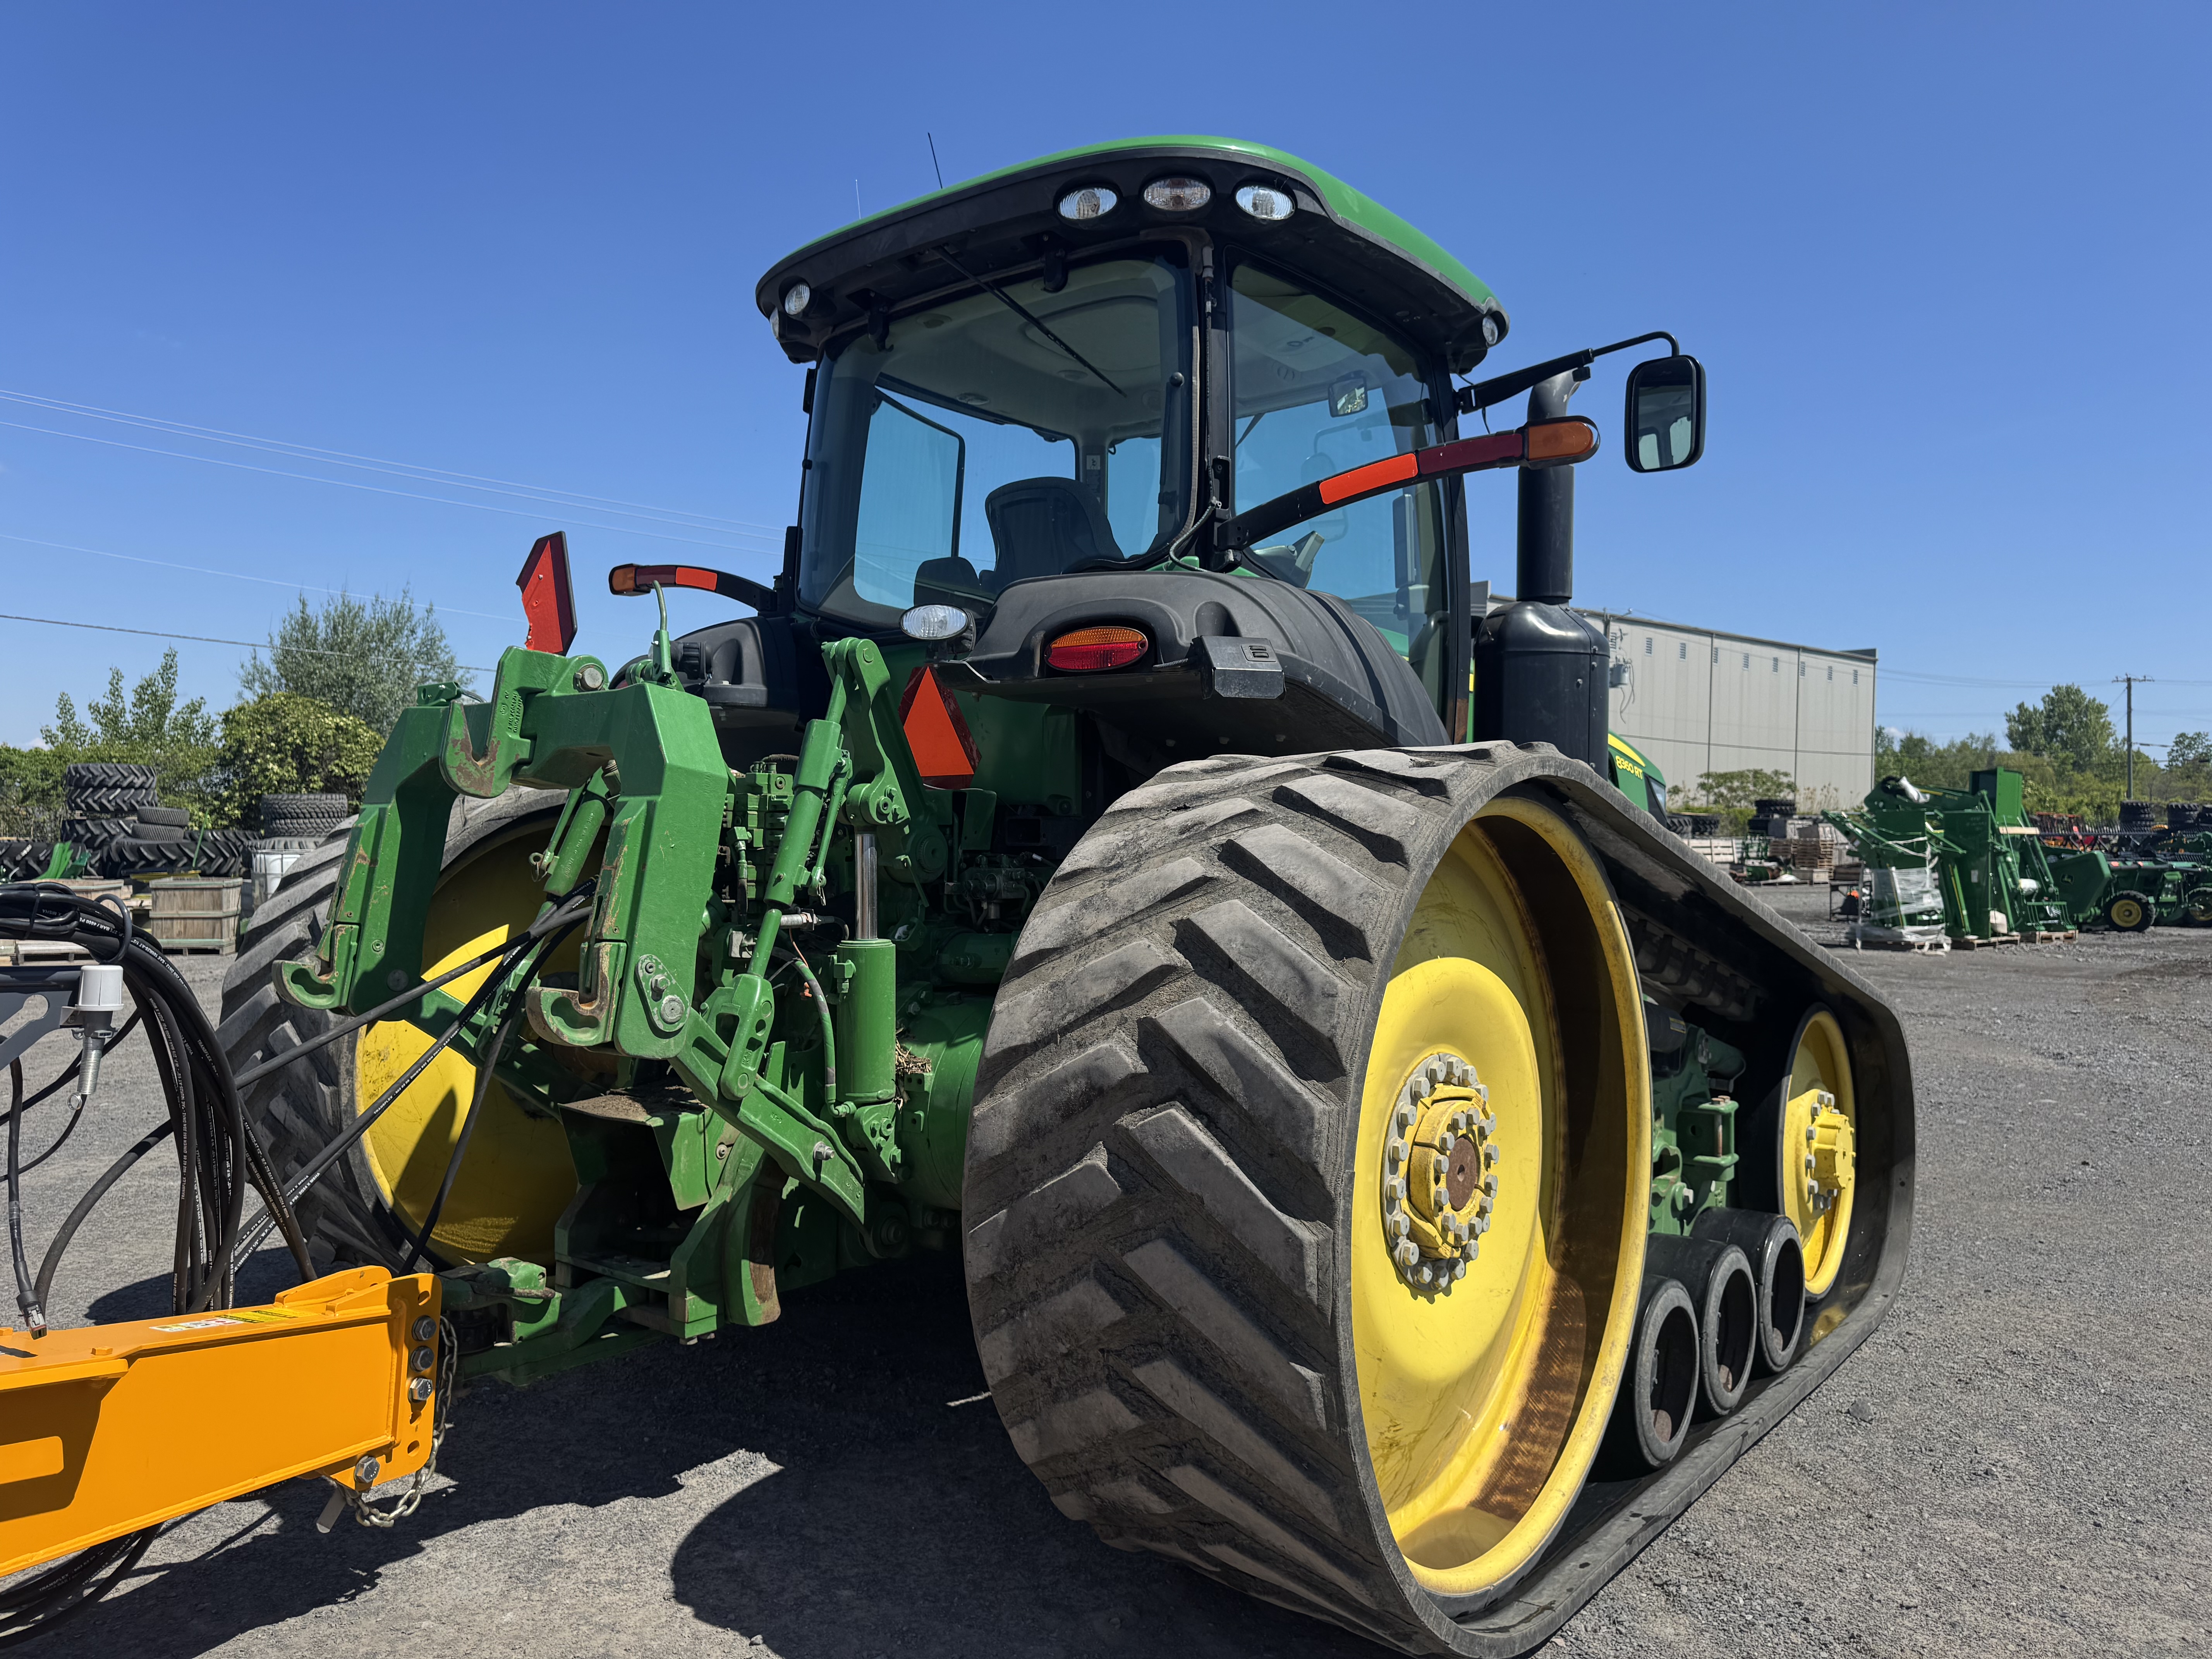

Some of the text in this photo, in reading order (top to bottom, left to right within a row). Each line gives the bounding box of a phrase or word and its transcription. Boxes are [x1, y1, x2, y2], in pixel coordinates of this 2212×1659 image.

[1616, 756, 1642, 780] 8360 RT
[571, 881, 592, 895] TRANSFLEX
[197, 1038, 212, 1062] TRANSFLEX
[372, 1095, 394, 1115] TRANSFLEX
[298, 1175, 309, 1185] MSHA
[309, 1172, 321, 1183] MSHA
[257, 1214, 267, 1224] BAR
[260, 1227, 270, 1238] W.P.
[82, 1561, 109, 1585] TRANSFLEX
[39, 1573, 69, 1591] TRANSFLEX
